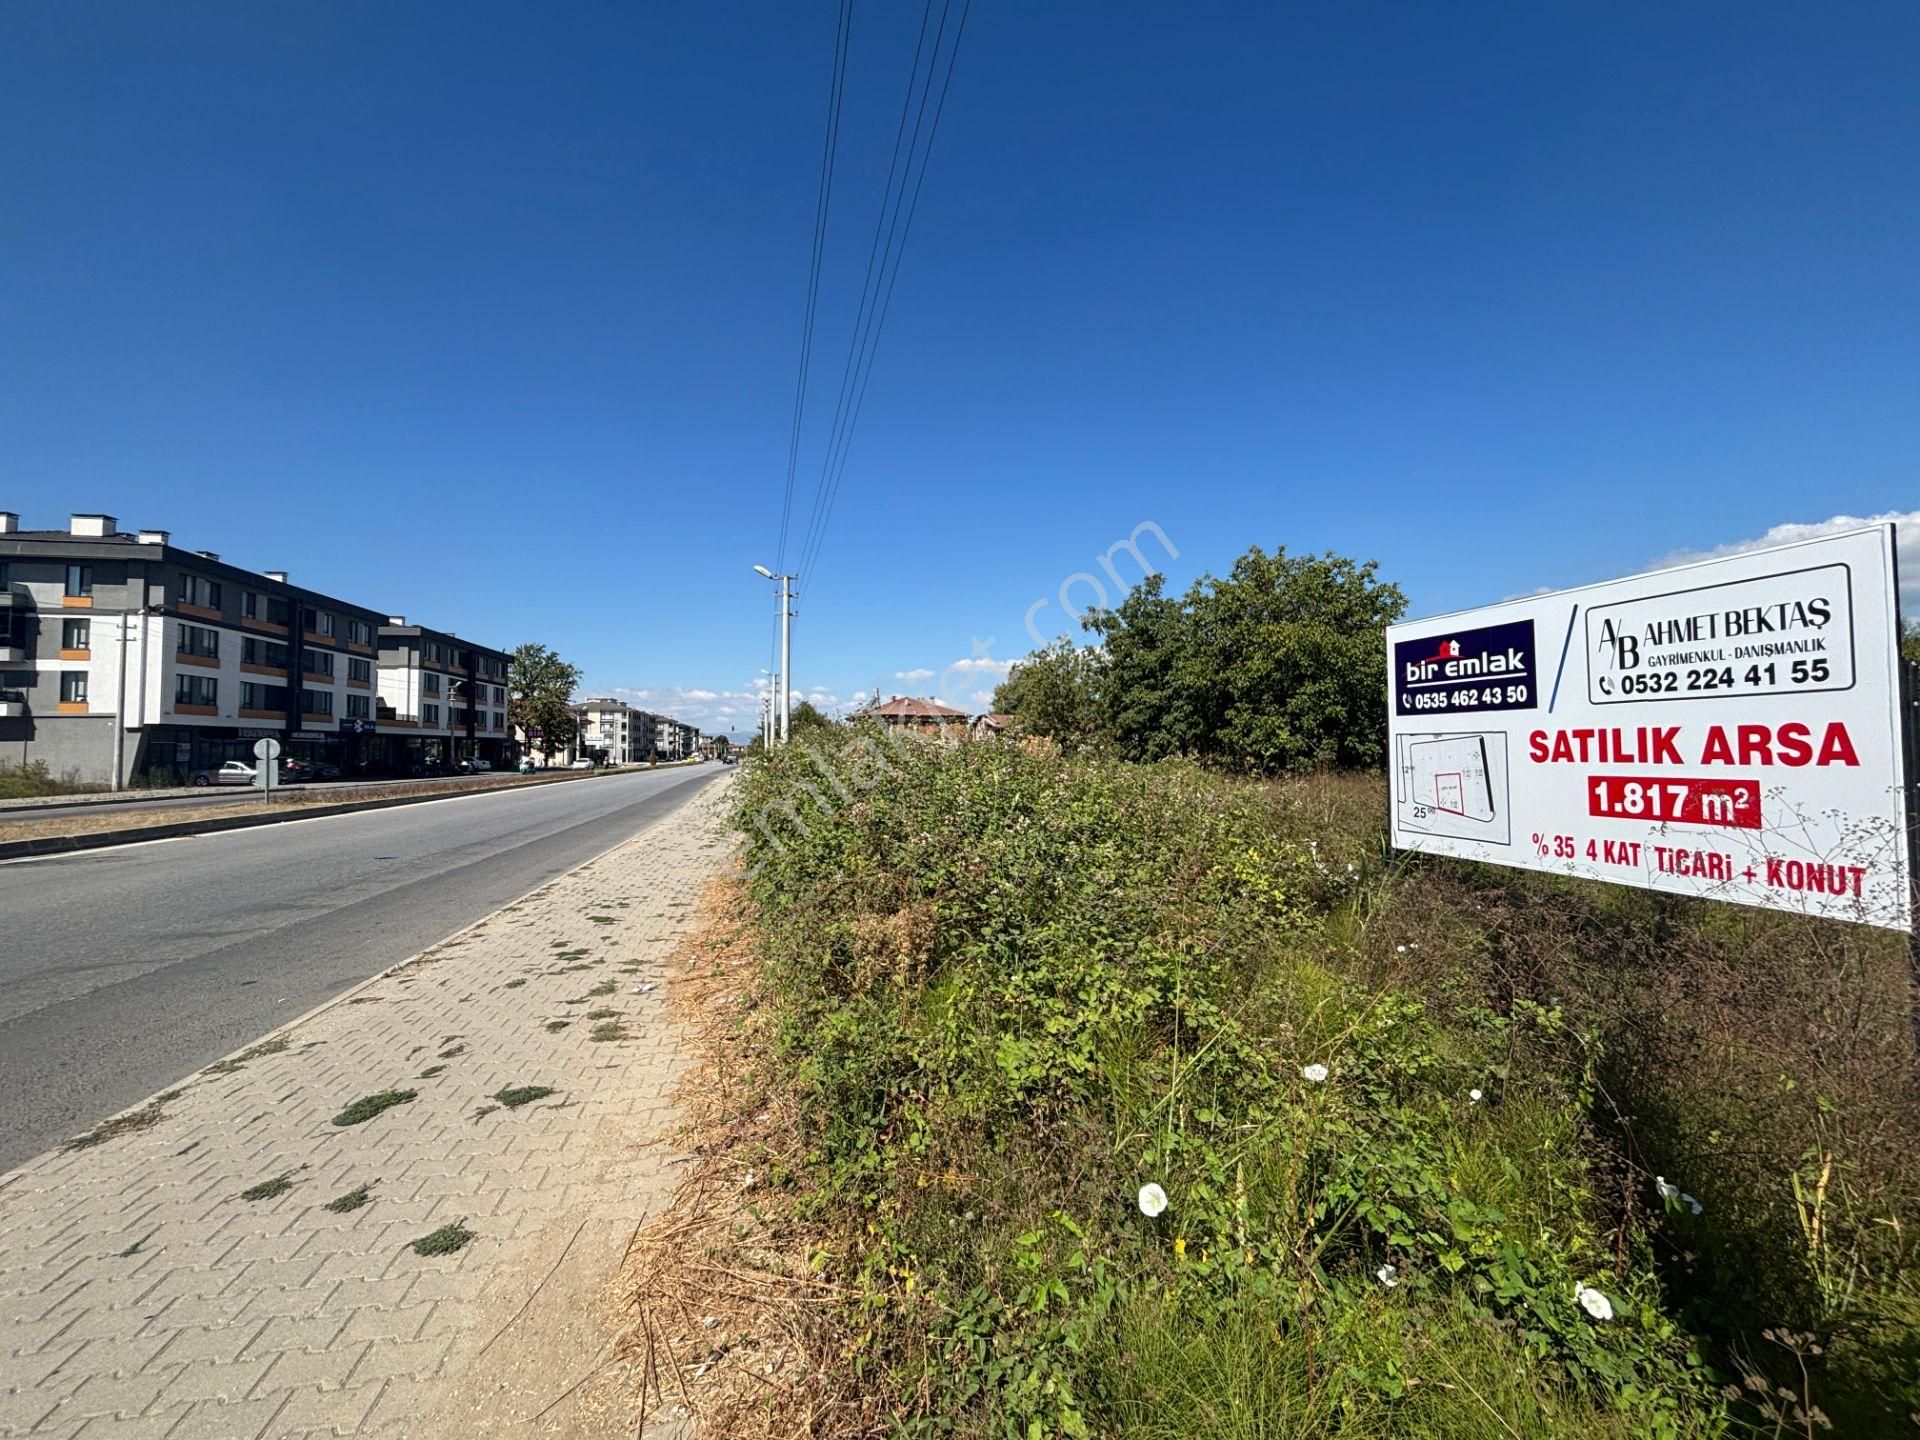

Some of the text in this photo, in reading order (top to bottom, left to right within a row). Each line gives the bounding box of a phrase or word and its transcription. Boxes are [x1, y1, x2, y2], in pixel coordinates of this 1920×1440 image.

[1643, 597, 1832, 647] AHMET BEKTAŞ
[1406, 648, 1526, 681] bir emlak
[1648, 651, 1727, 668] GAYRİMENKUL
[1734, 637, 1827, 659] DANIŞMANLIK
[1621, 658, 1830, 695] 0532 224 41 55
[1415, 685, 1528, 709] 0535 462 43 50
[1529, 722, 1861, 766] SATILIK ARSA
[1594, 781, 1689, 818] 1.817
[1532, 833, 1549, 855] %
[1553, 835, 1575, 859] 35
[1586, 839, 1597, 862] 4
[1603, 840, 1641, 867] KAT
[1742, 865, 1757, 884] +
[1766, 857, 1867, 897] KONUT
